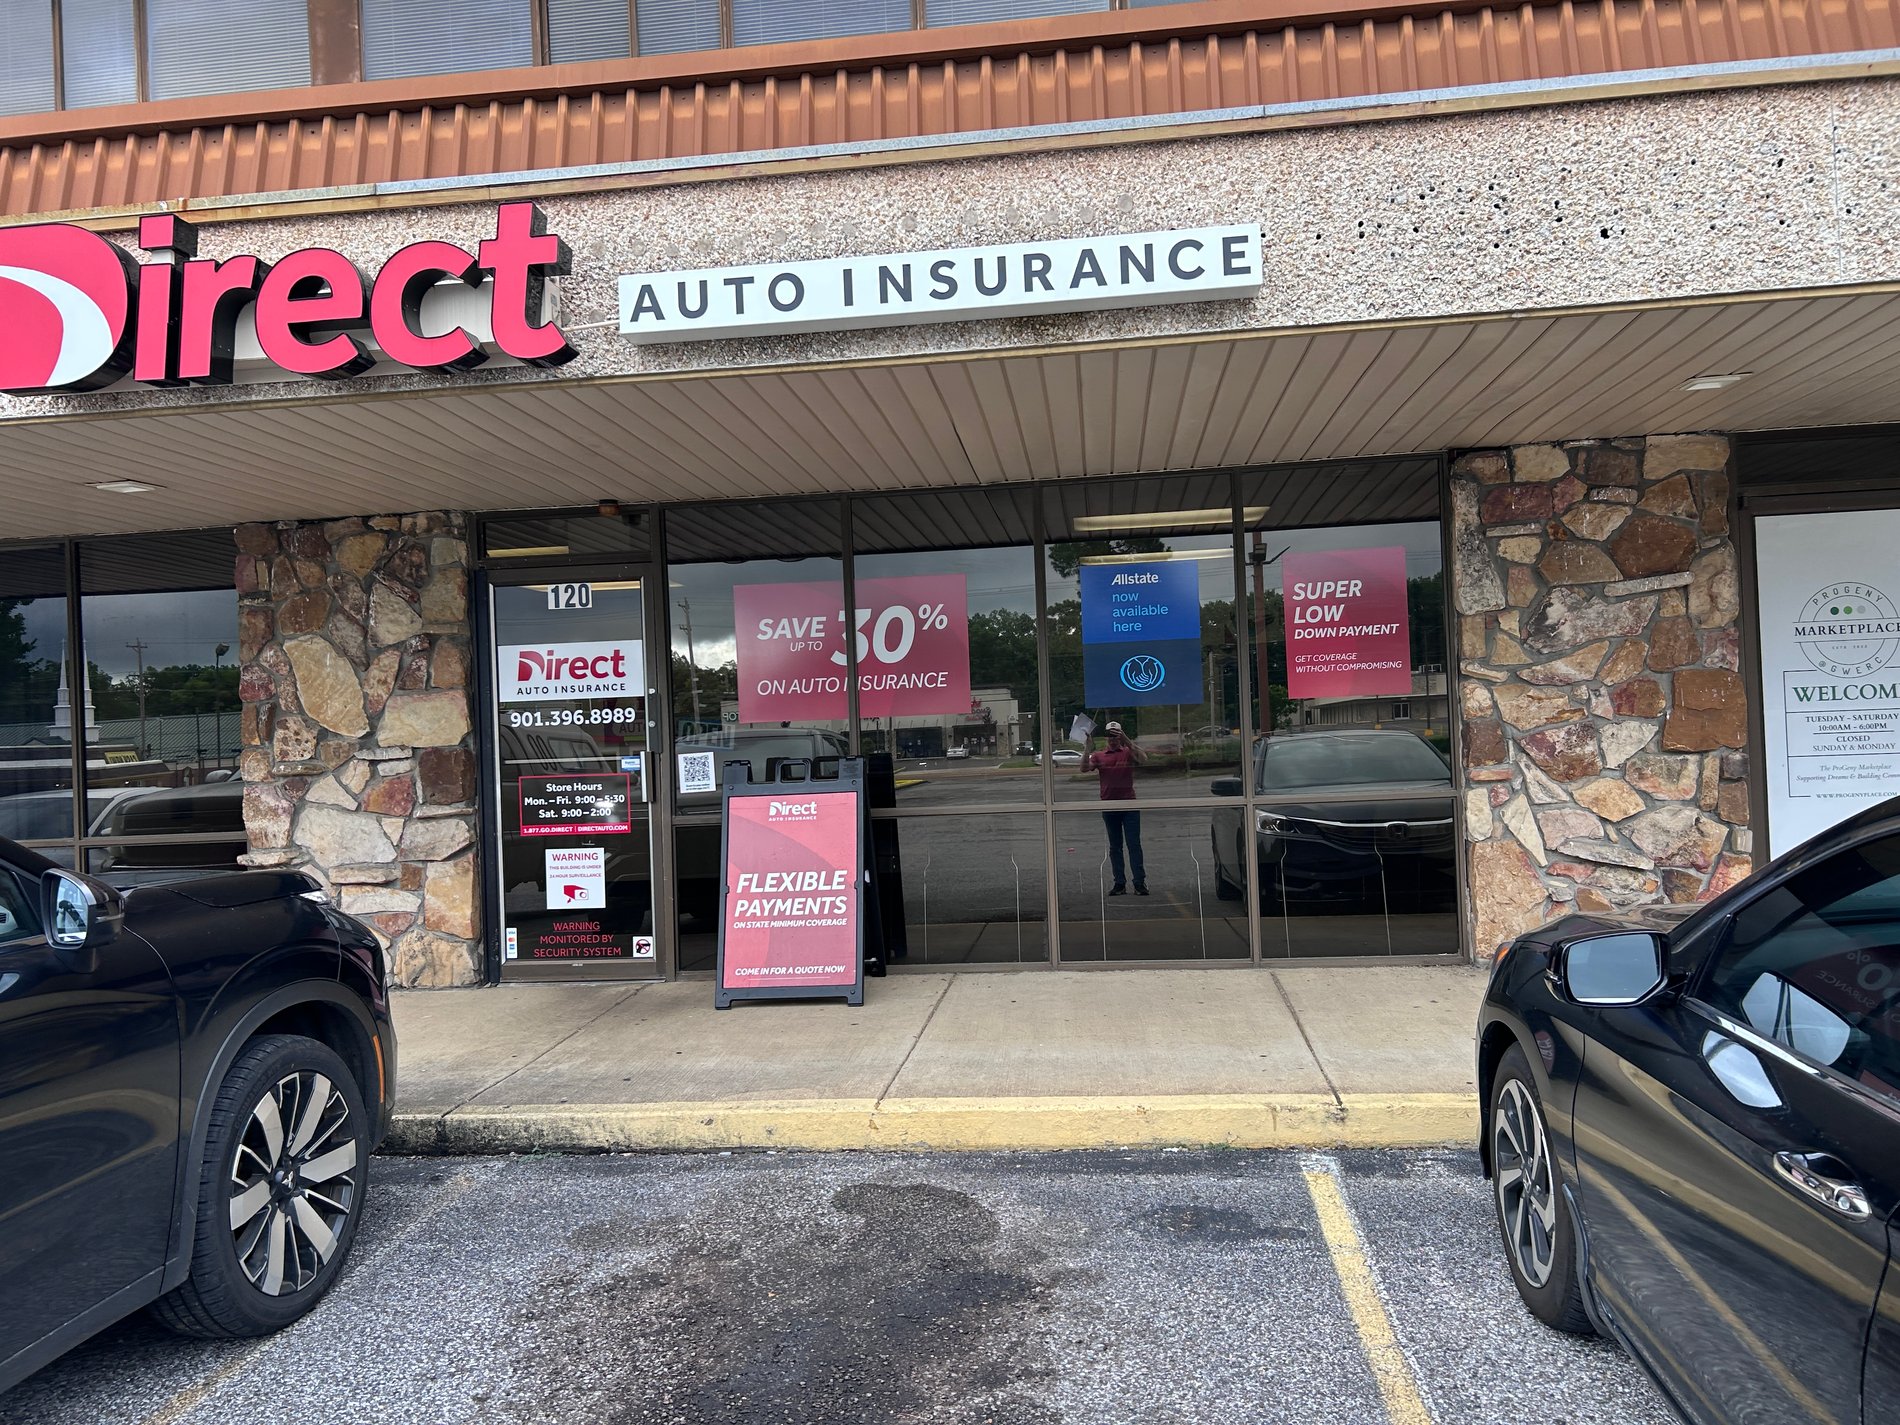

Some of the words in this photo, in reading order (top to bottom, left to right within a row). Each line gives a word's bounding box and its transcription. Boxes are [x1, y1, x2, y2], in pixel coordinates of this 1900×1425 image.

[629, 272, 805, 322] AUTO
[843, 235, 1251, 307] INSURANCE
[0, 202, 572, 390] Direct
[1111, 572, 1159, 586] Allstate
[551, 584, 590, 608] 120
[1292, 579, 1363, 601] SUPER
[1812, 586, 1883, 606] PROGENY
[1112, 592, 1139, 602] now
[1112, 604, 1169, 617] available
[1294, 604, 1345, 624] LOW
[756, 616, 827, 640] SAVE
[1113, 621, 1142, 632] here
[1294, 627, 1336, 640] DOWN
[1338, 623, 1400, 637] PAYMENT
[790, 641, 805, 652] UP
[807, 641, 823, 651] TO
[1295, 654, 1313, 663] GET
[1313, 652, 1358, 662] COVERAGE
[517, 649, 627, 681] Direct
[1296, 664, 1336, 673] WITHOUT
[1336, 661, 1403, 672] COMPROMISING
[517, 686, 549, 695] AUTO
[554, 683, 626, 694] INSURANCE
[757, 679, 785, 696] ON
[788, 676, 840, 695] AUTO
[1792, 683, 1900, 703] WELCOM
[510, 707, 636, 728] 901.396.8989
[1805, 715, 1846, 723] TUESDAY
[1852, 713, 1900, 721] SATURDAY
[1818, 724, 1851, 732] 10:00AM
[1858, 722, 1888, 730] 6:00PM
[1836, 735, 1871, 743] CLOSED
[1813, 744, 1847, 752] SUNDAY
[1857, 742, 1896, 750] MONDAY
[1858, 763, 1892, 771] Marketplace
[1796, 774, 1826, 783] Supporting
[1857, 772, 1881, 781] Building
[546, 783, 572, 792] Store
[573, 782, 603, 792] Hours
[524, 797, 548, 806] Mon.
[556, 795, 572, 805] Fri.
[575, 795, 596, 804] 9:00
[604, 794, 625, 803] 5:30
[1816, 791, 1898, 799] WWW.PROGENYPLACE.COM
[538, 809, 559, 818] Sat.
[561, 808, 582, 817] 9:00
[590, 808, 612, 817] 2:00
[768, 801, 818, 816] Direct
[523, 826, 574, 834] 1.877.GO.DIRECT
[552, 852, 599, 862] WARNING
[736, 870, 848, 894] FLEXIBLE
[734, 895, 848, 918] PAYMENTS
[553, 921, 600, 931] WARNING
[733, 921, 746, 929] ON
[746, 920, 770, 928] STATE
[770, 919, 805, 928] MINIMUM
[806, 918, 848, 927] COVERAGE
[540, 934, 600, 945] MONITORED
[602, 934, 614, 943] BY
[533, 947, 580, 958] SECURITY
[583, 946, 622, 957] SYSTEM
[735, 968, 759, 976] COME
[760, 967, 769, 975] IN
[769, 967, 787, 975] FOR
[787, 967, 794, 975] A
[794, 966, 825, 975] QUOTE
[824, 965, 846, 973] NOW
